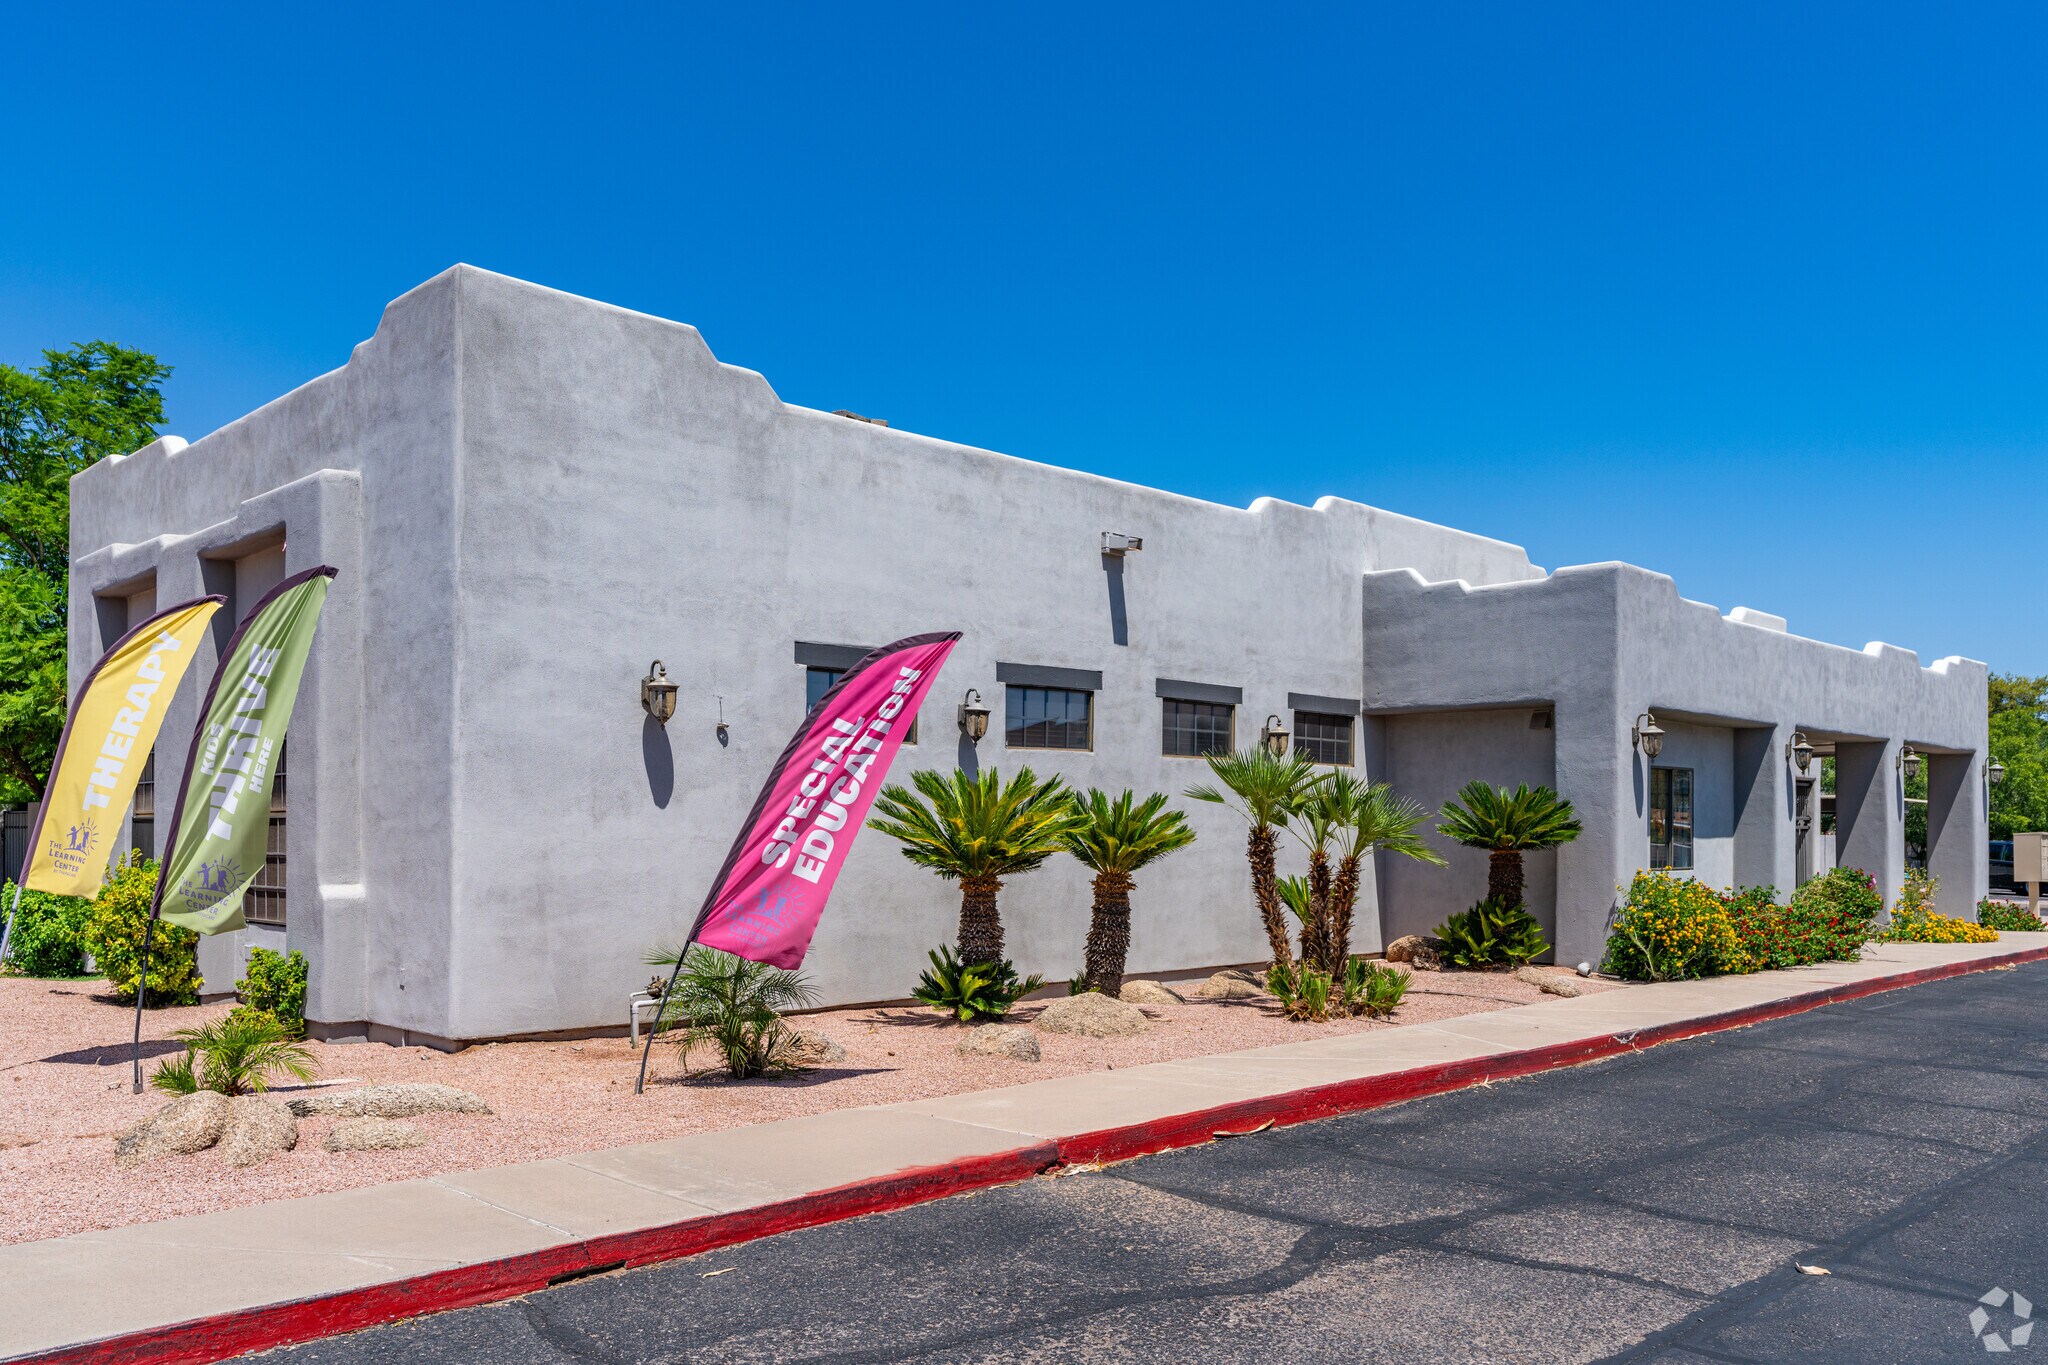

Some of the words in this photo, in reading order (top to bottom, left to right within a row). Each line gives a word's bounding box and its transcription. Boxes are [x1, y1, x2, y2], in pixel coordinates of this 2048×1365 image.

[83, 630, 182, 811] THERAPY
[200, 723, 225, 776] KIDS
[205, 643, 281, 841] THRIVE
[249, 736, 274, 793] HERE
[792, 666, 922, 884] EDUCATION
[761, 716, 866, 869] SPECIAL
[49, 848, 86, 864] LEARNING
[50, 840, 62, 849] THE
[54, 860, 79, 872] CENTER
[179, 886, 229, 906] LEARNING
[186, 899, 218, 914] CENTER
[725, 908, 780, 936] LEARNING
[729, 923, 768, 943] CENTER
